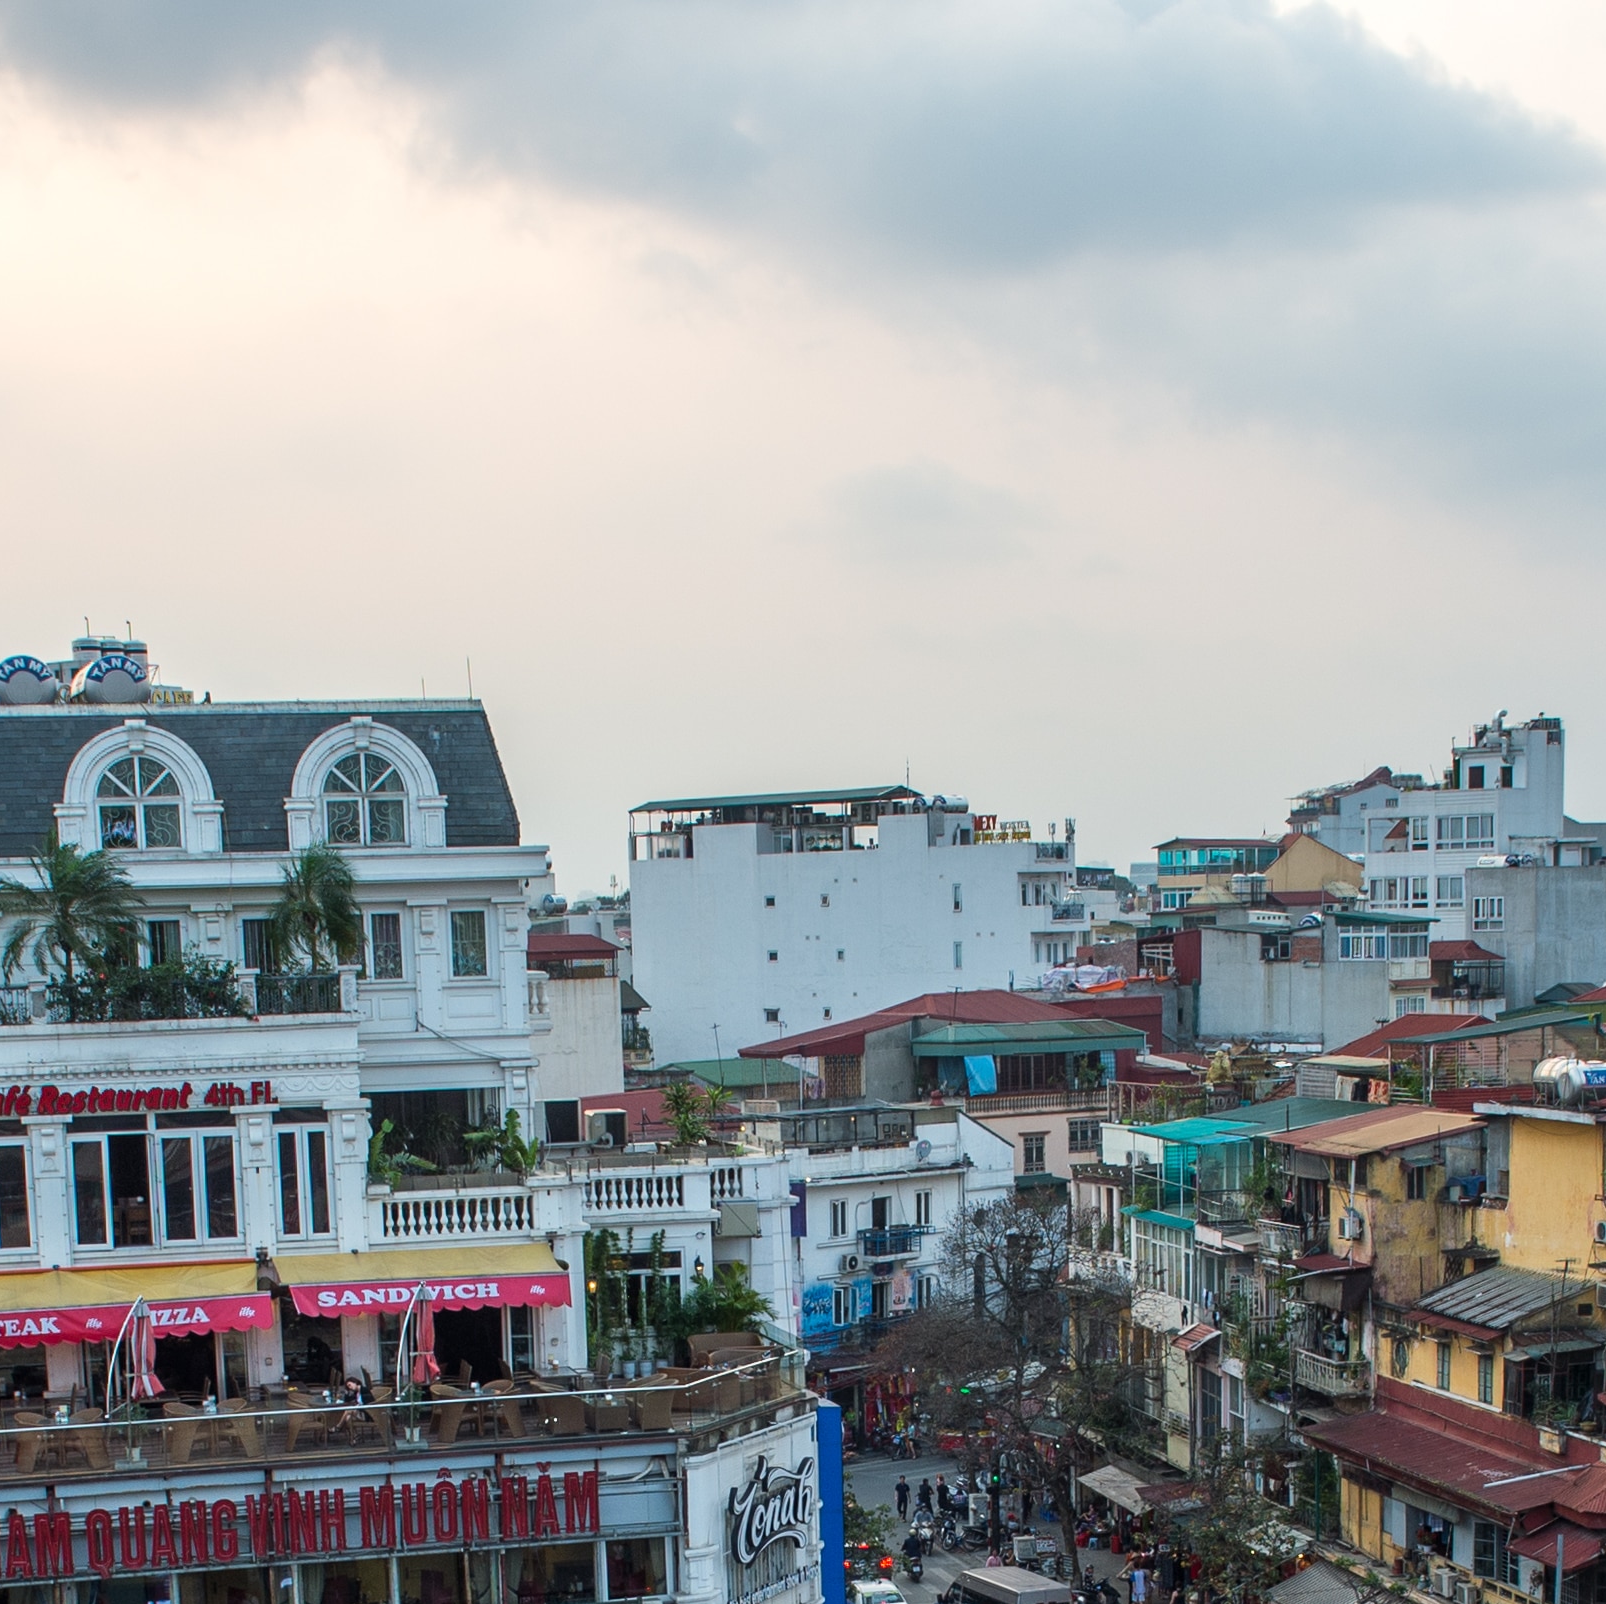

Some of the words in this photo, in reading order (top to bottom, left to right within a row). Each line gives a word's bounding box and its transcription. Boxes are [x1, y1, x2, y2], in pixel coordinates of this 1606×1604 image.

[37, 1081, 194, 1116] Restaurant
[204, 1082, 245, 1106] 4th
[317, 1282, 500, 1307] SANDWICH
[530, 1284, 546, 1295] illy
[85, 1317, 103, 1330] illy
[148, 1307, 211, 1326] IZZA
[239, 1305, 256, 1318] illy
[84, 1498, 240, 1580] QUANG
[244, 1487, 345, 1562] VINH
[359, 1466, 490, 1549] MUÔN
[503, 1461, 600, 1539] NĂM
